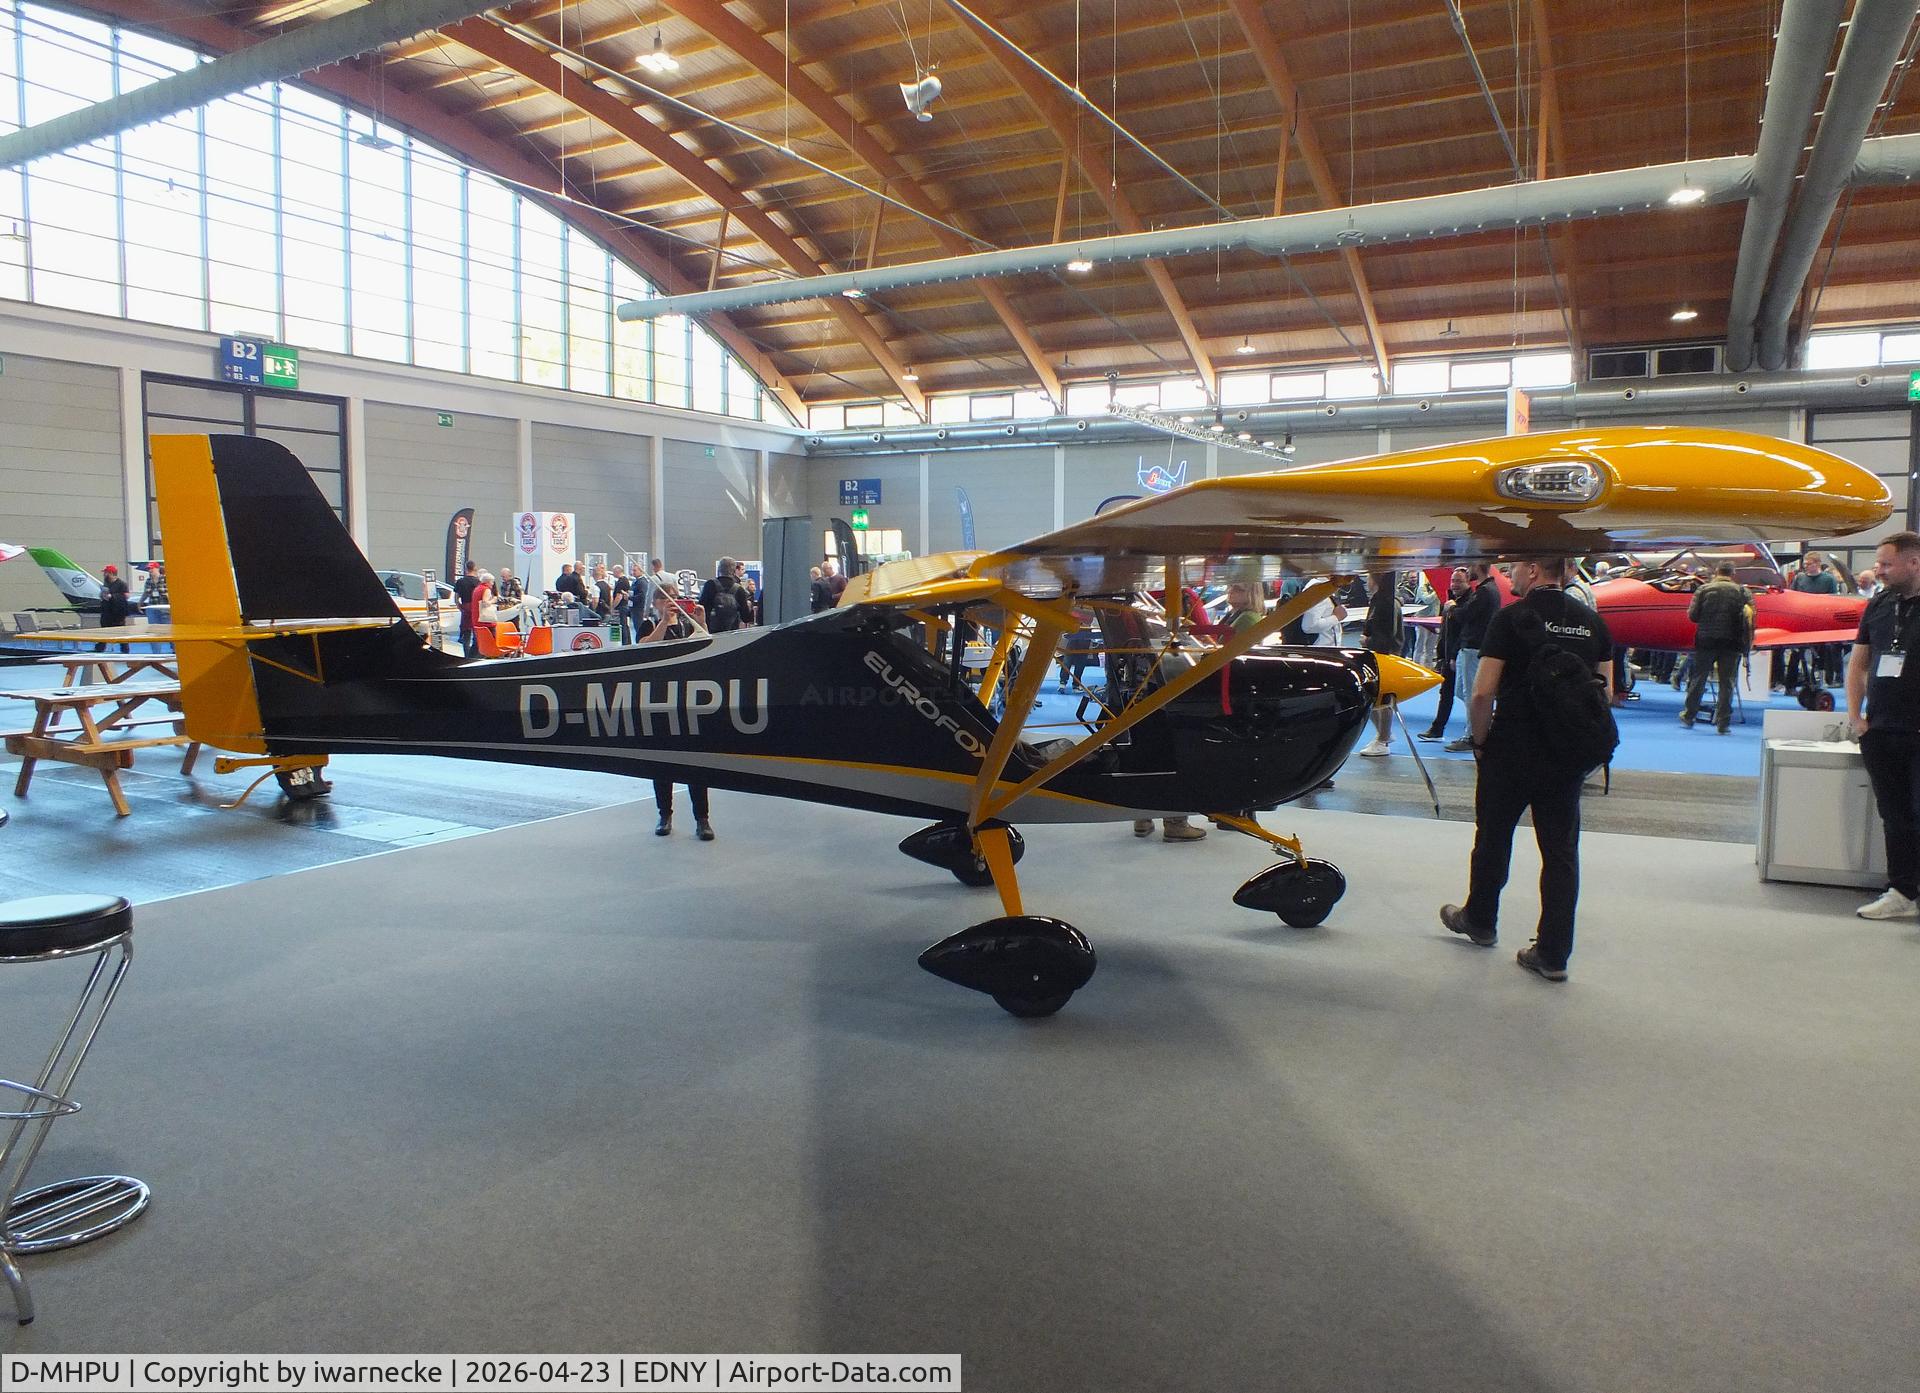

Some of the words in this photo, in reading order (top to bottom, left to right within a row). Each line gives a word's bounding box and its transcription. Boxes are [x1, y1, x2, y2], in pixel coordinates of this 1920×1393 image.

[232, 341, 257, 360] B2
[233, 365, 243, 373] B1
[845, 480, 858, 491] B2
[520, 678, 769, 739] D-MHPU
